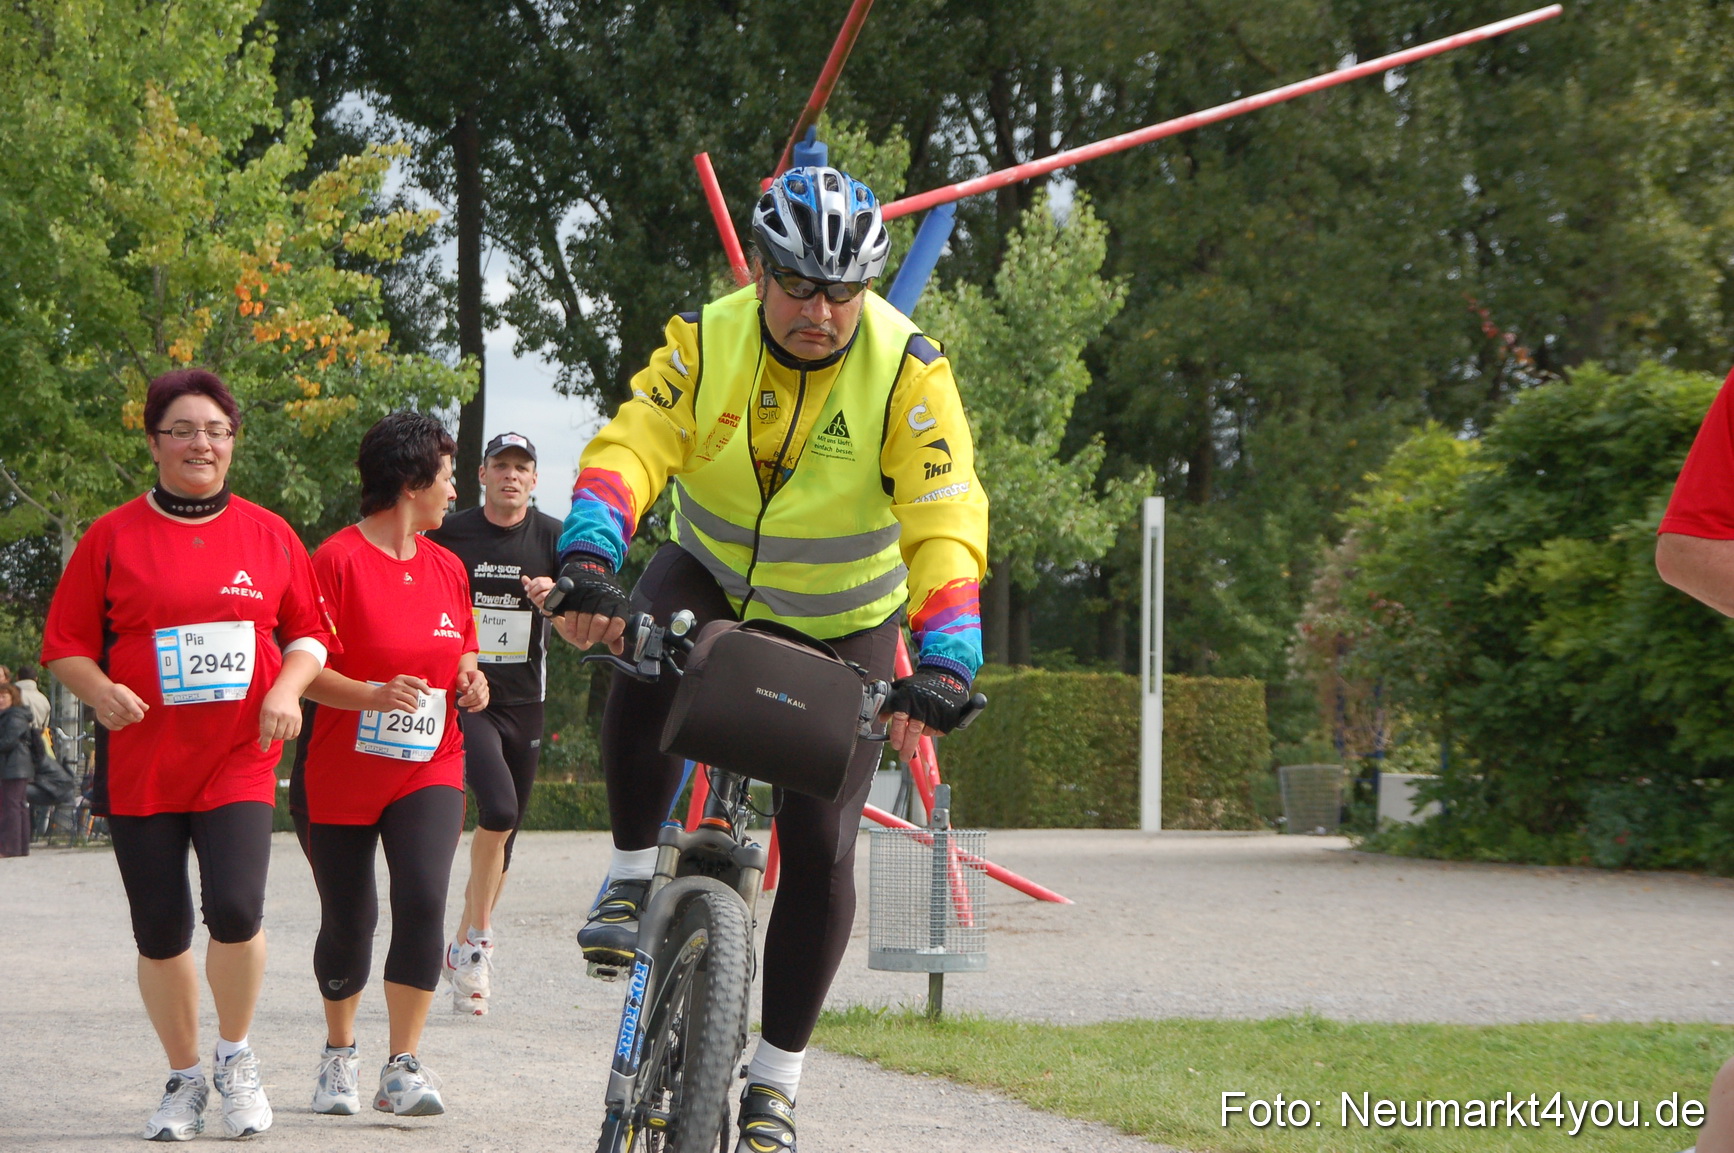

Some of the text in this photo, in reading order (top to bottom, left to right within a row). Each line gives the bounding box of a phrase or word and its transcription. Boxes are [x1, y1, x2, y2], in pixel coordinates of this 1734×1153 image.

[923, 461, 952, 481] iko
[497, 564, 521, 575] SPORT
[220, 586, 264, 600] AREVA
[475, 591, 521, 605] PowerBar
[482, 614, 507, 626] Artur
[185, 633, 204, 646] Pia
[433, 628, 462, 639] AREVA
[498, 632, 508, 646] 4
[189, 652, 246, 675] 2942
[756, 687, 807, 711] RIXEN KAUL
[386, 713, 435, 736] 2940
[626, 961, 650, 1006] FOX
